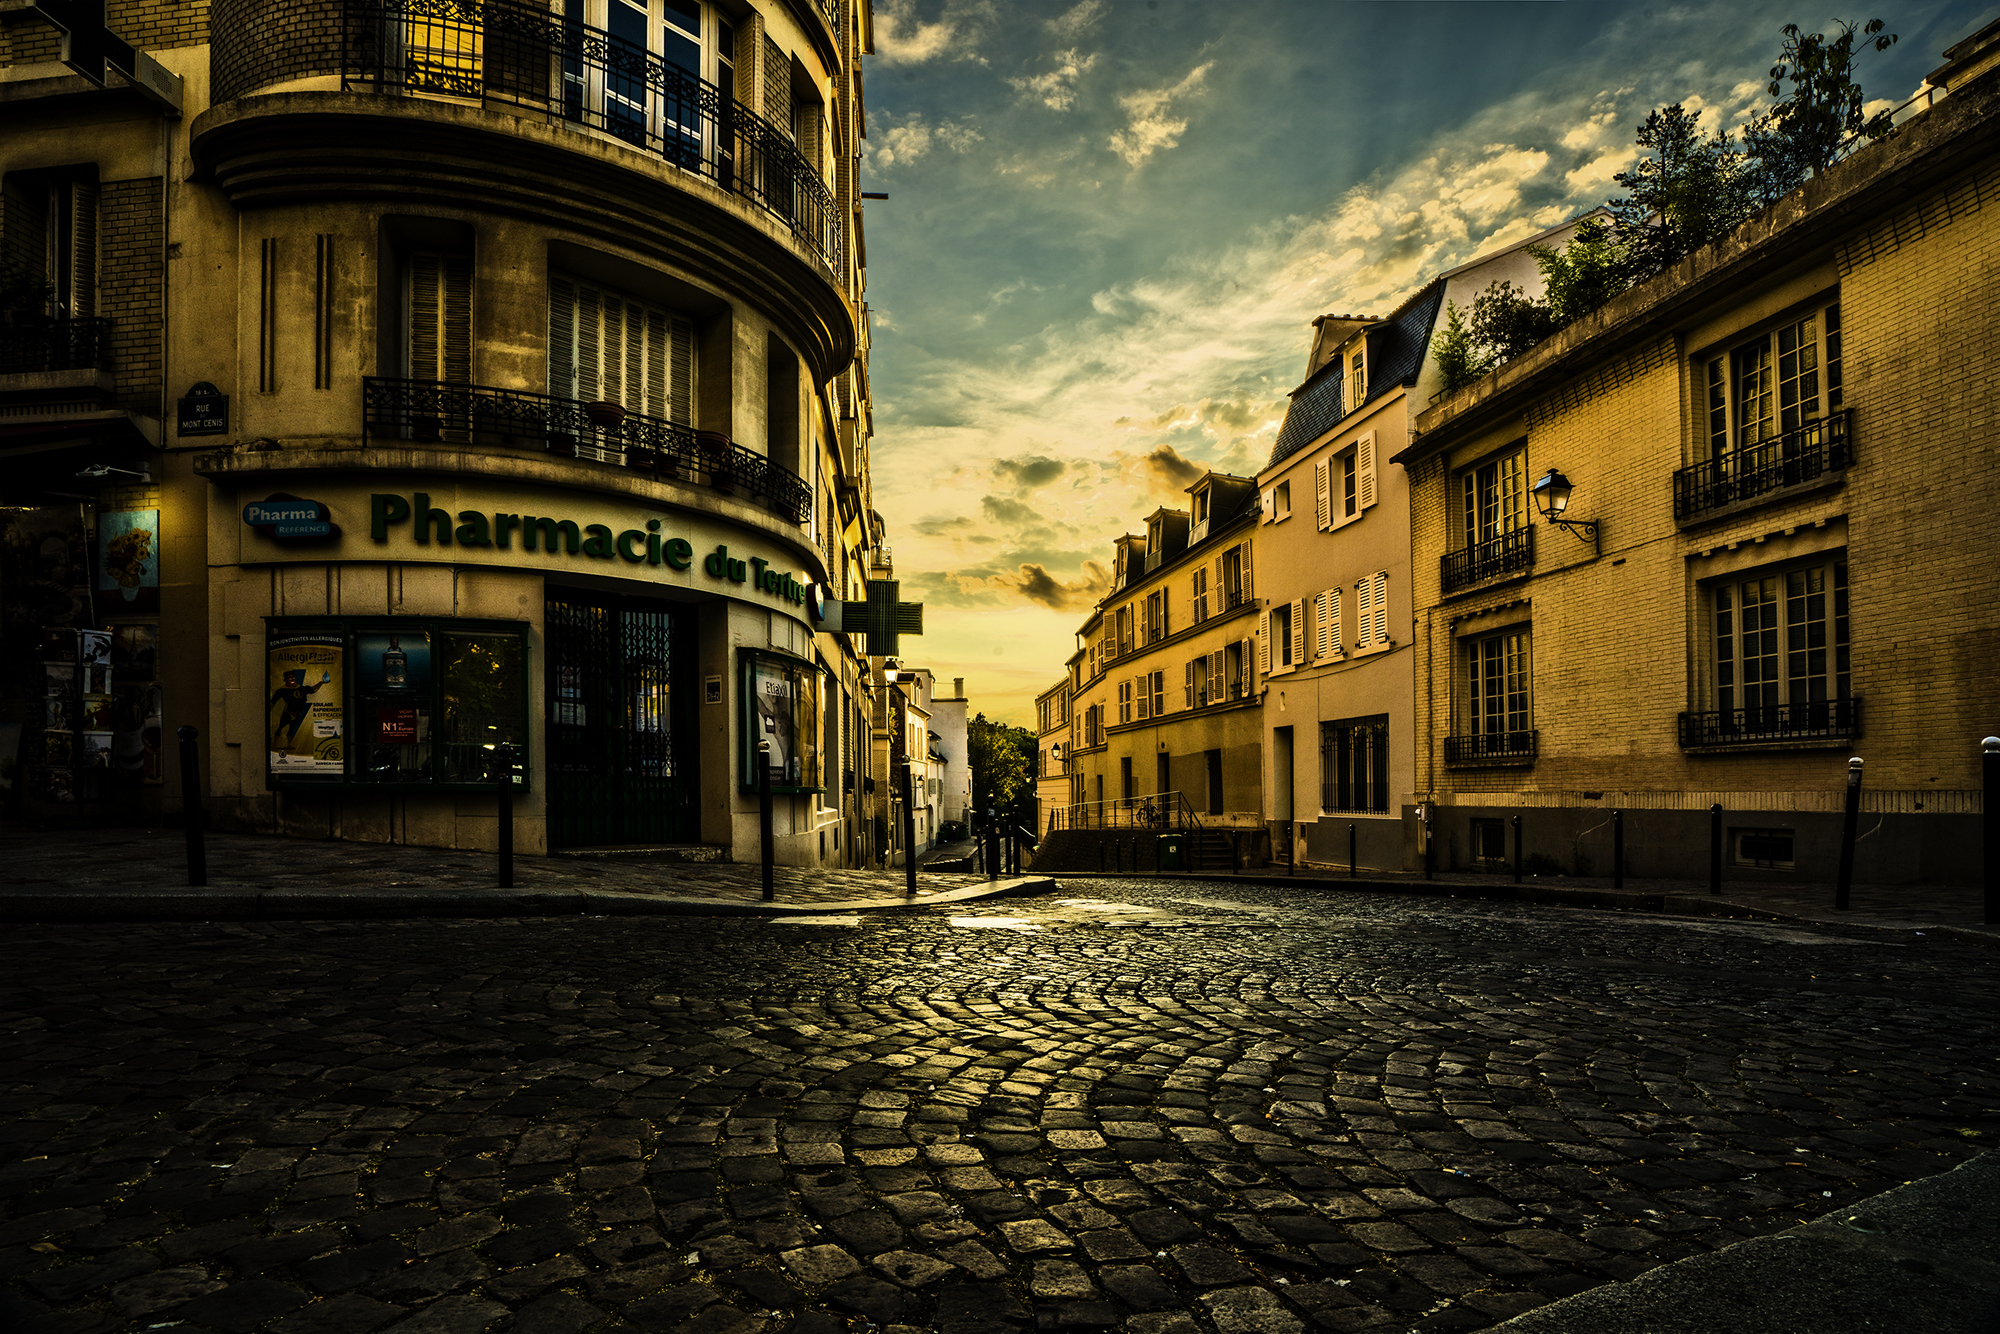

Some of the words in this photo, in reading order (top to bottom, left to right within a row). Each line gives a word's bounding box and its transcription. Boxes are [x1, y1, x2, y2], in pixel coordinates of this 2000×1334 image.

[196, 404, 210, 412] RUE
[182, 420, 201, 428] MONT
[203, 418, 223, 427] CENIS
[248, 507, 316, 521] Pharma
[370, 492, 693, 569] Pharmacie
[707, 545, 747, 583] du
[752, 555, 806, 605] Tertre
